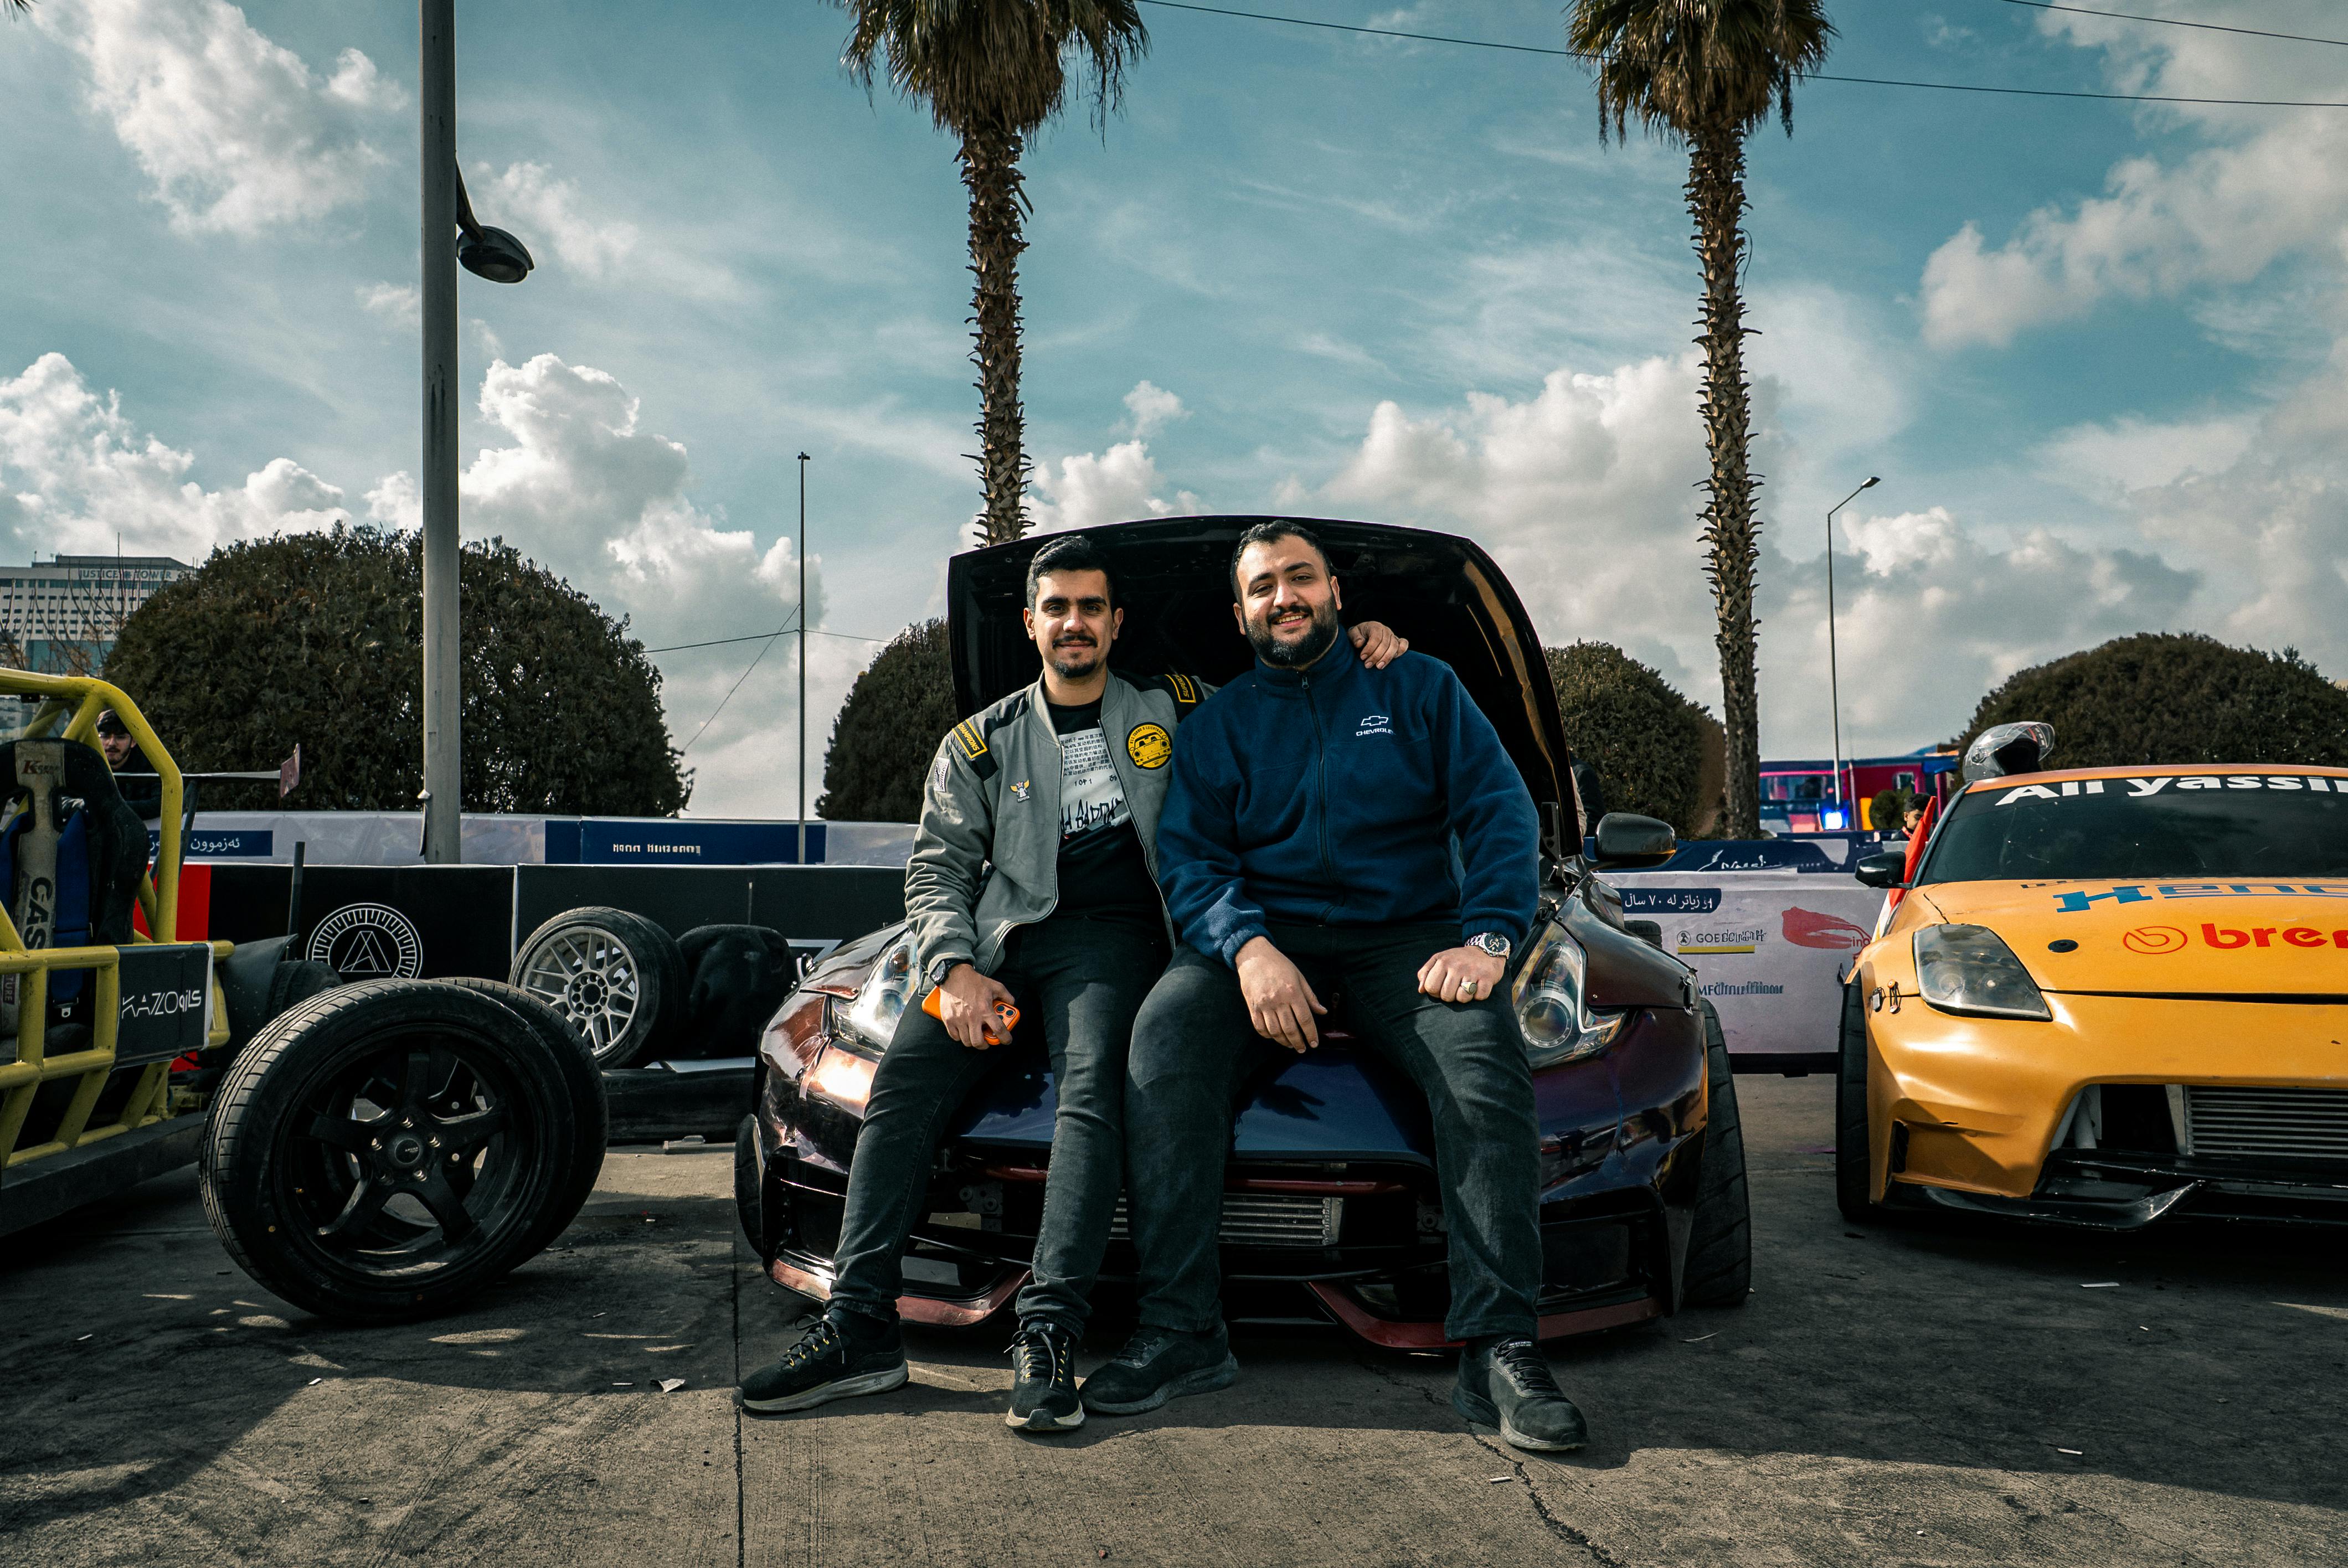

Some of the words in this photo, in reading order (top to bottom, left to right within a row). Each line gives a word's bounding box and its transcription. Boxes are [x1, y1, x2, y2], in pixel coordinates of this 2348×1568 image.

[80, 570, 118, 578] JUSTICE
[136, 570, 172, 579] TOWER
[2201, 923, 2348, 950] bre
